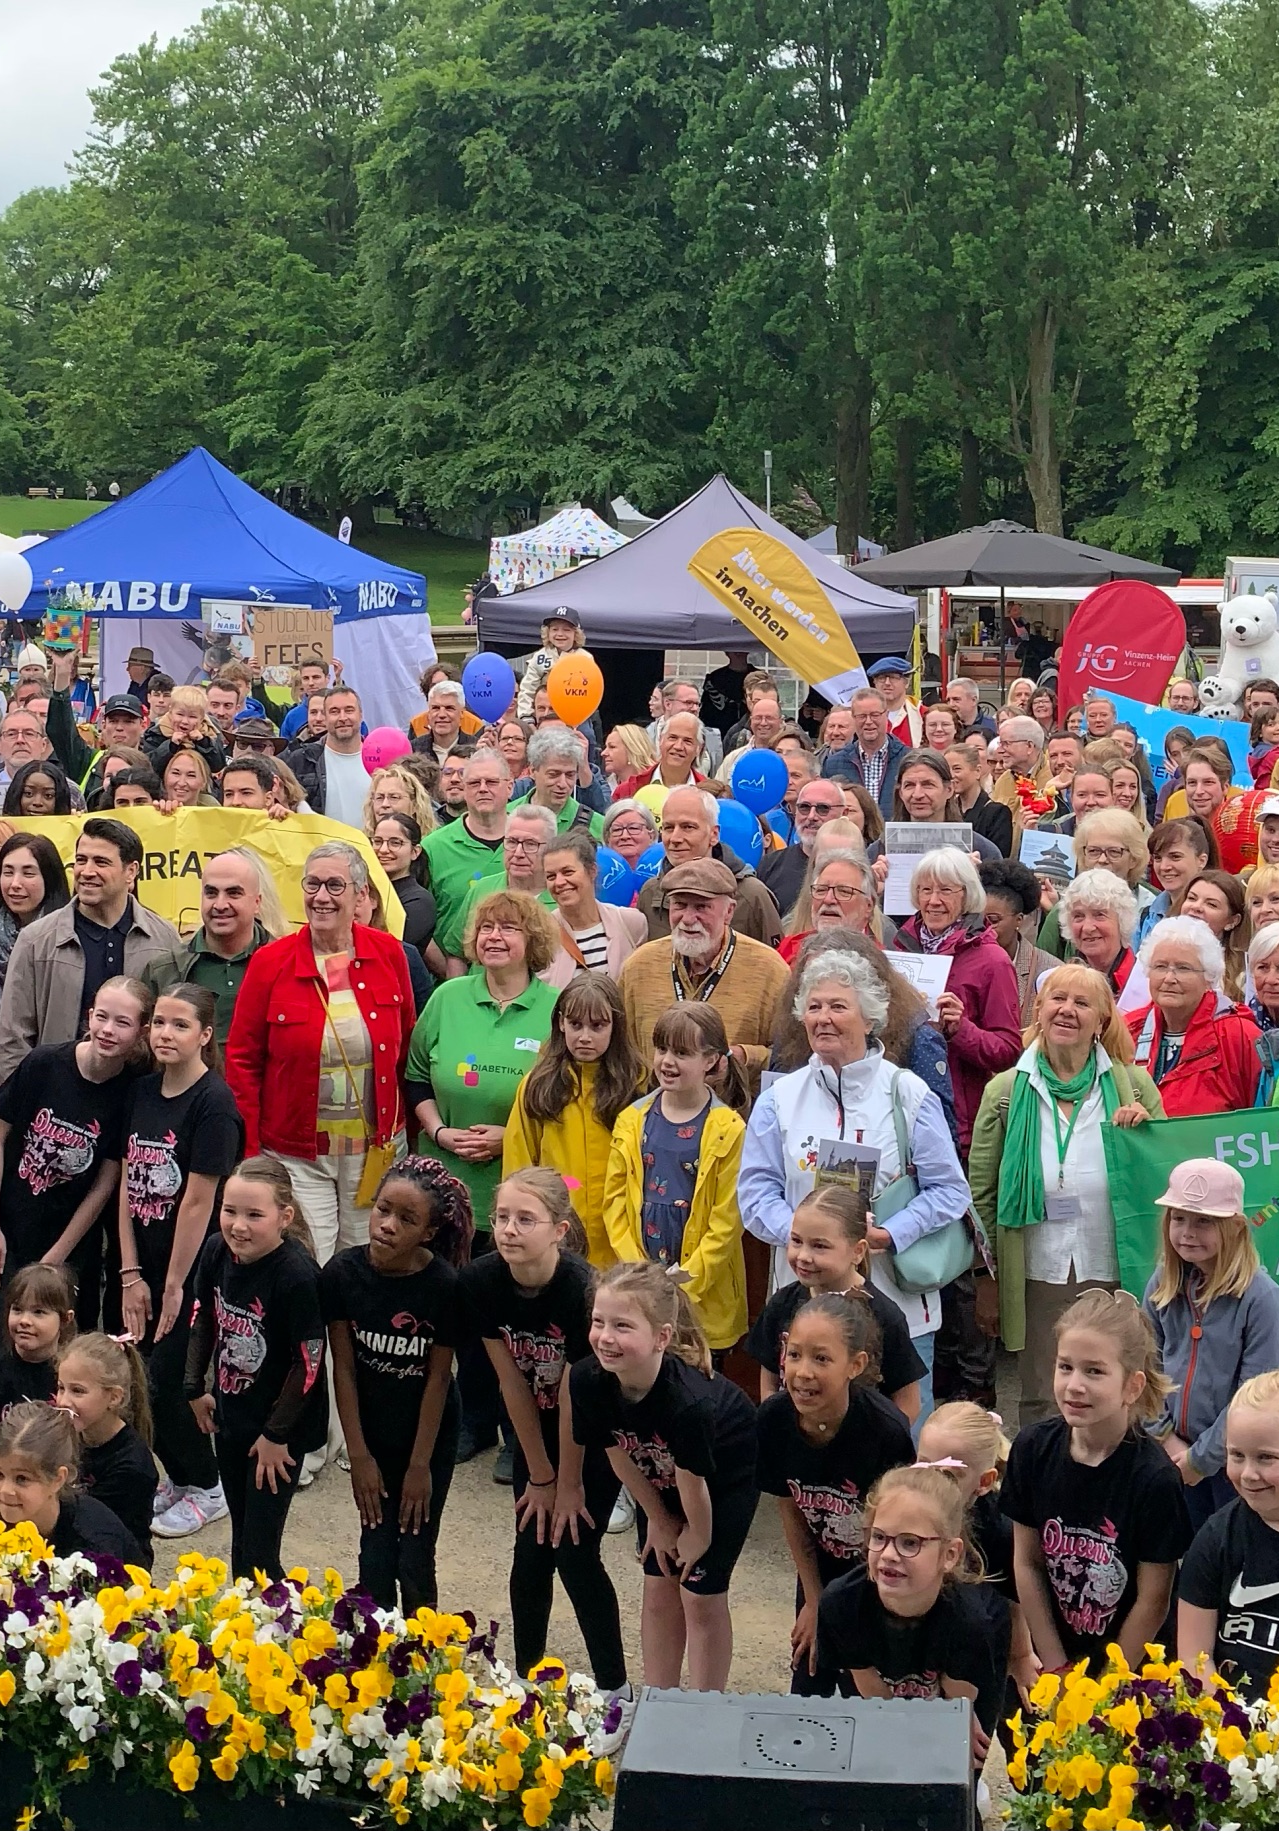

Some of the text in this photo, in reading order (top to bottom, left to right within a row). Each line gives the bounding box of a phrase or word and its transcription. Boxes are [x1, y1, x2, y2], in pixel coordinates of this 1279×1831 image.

[66, 581, 192, 612] NABU
[358, 581, 399, 612] NABU
[715, 566, 790, 642] in Aachen
[731, 547, 830, 645] Älter werden
[217, 622, 241, 630] NABU
[254, 609, 334, 634] STUDENTS
[264, 641, 324, 665] FEES
[1123, 660, 1151, 668] AACHEN
[564, 688, 588, 696] VKM
[32, 1107, 88, 1150] Queens
[1042, 1519, 1113, 1566] Queens
